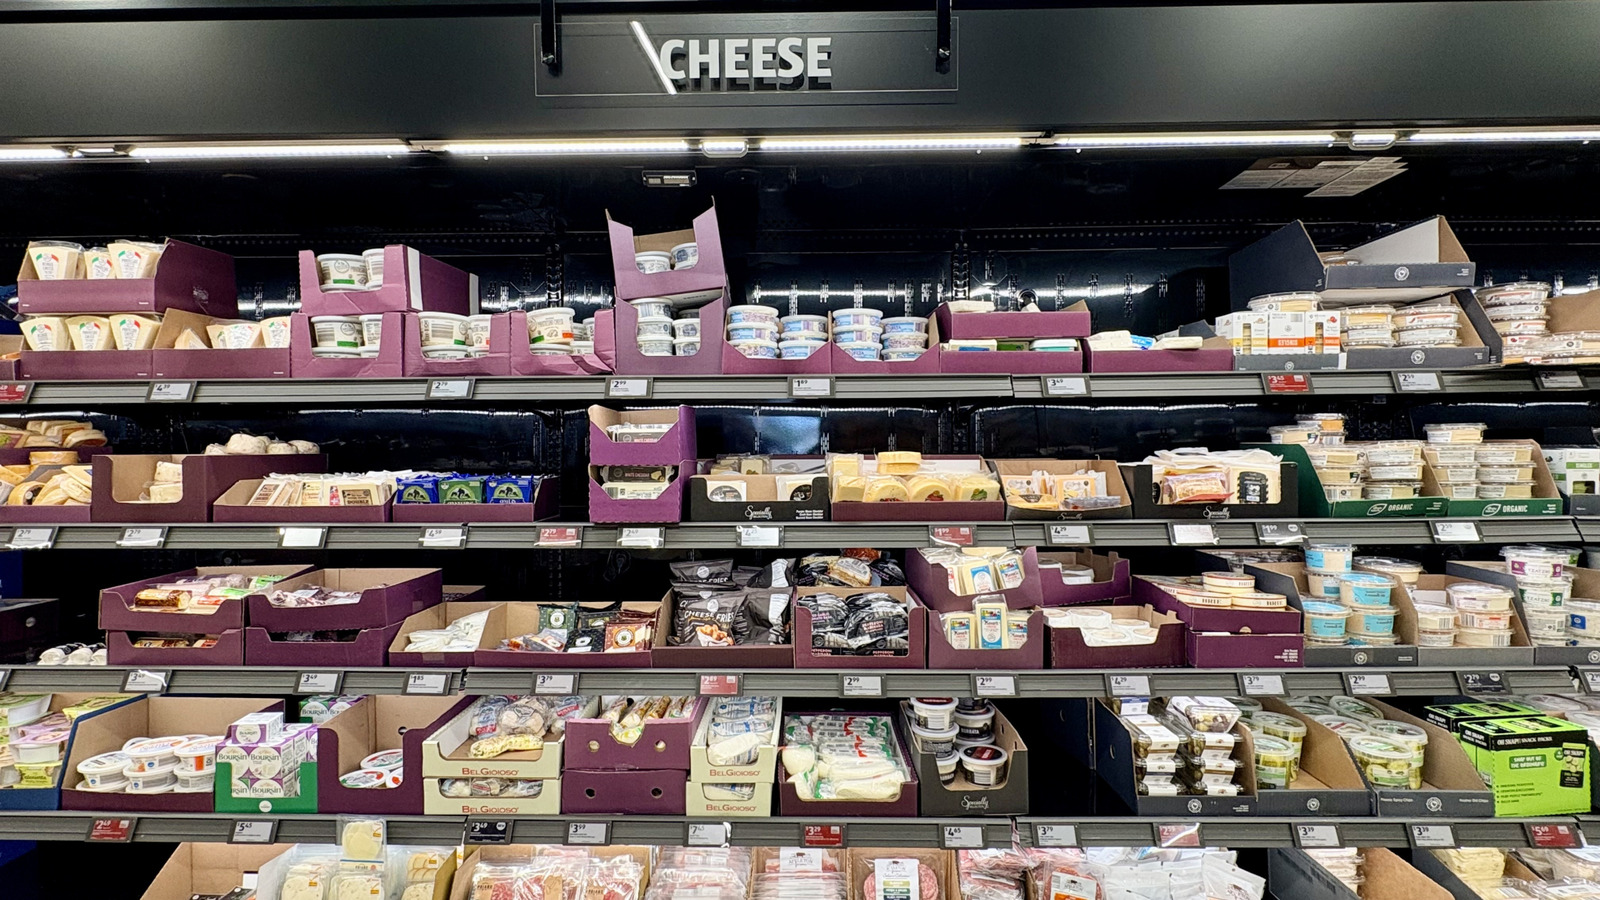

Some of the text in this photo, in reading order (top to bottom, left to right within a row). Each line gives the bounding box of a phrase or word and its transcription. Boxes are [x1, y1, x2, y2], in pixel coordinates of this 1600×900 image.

[660, 37, 832, 80] CHEESE
[684, 608, 734, 622] CHEESE FRIES
[250, 754, 280, 762] Boursin
[251, 787, 282, 796] Boursin
